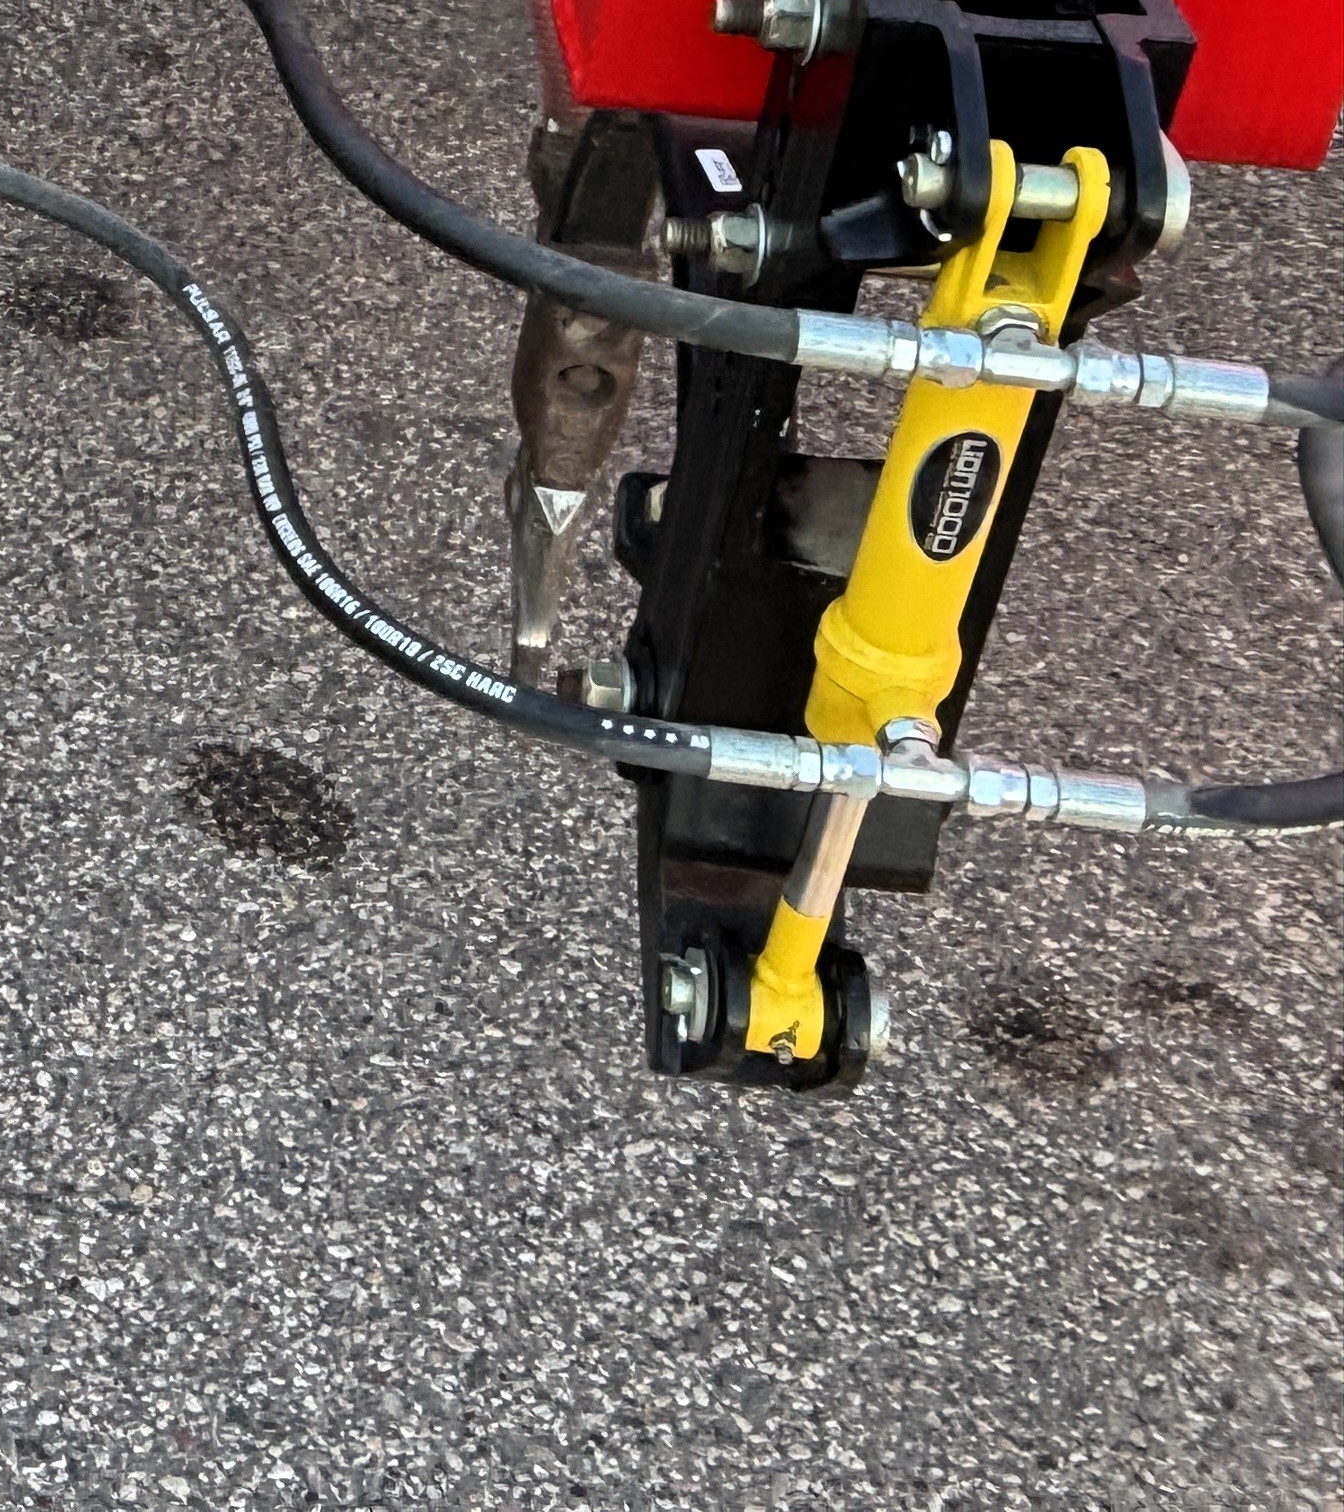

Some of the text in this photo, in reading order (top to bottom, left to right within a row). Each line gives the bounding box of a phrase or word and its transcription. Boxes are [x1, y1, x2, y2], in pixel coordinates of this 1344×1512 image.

[182, 283, 231, 345] PULSAR
[314, 572, 361, 615] 100R16
[429, 654, 467, 681] 2SC
[465, 671, 518, 704] HARC
